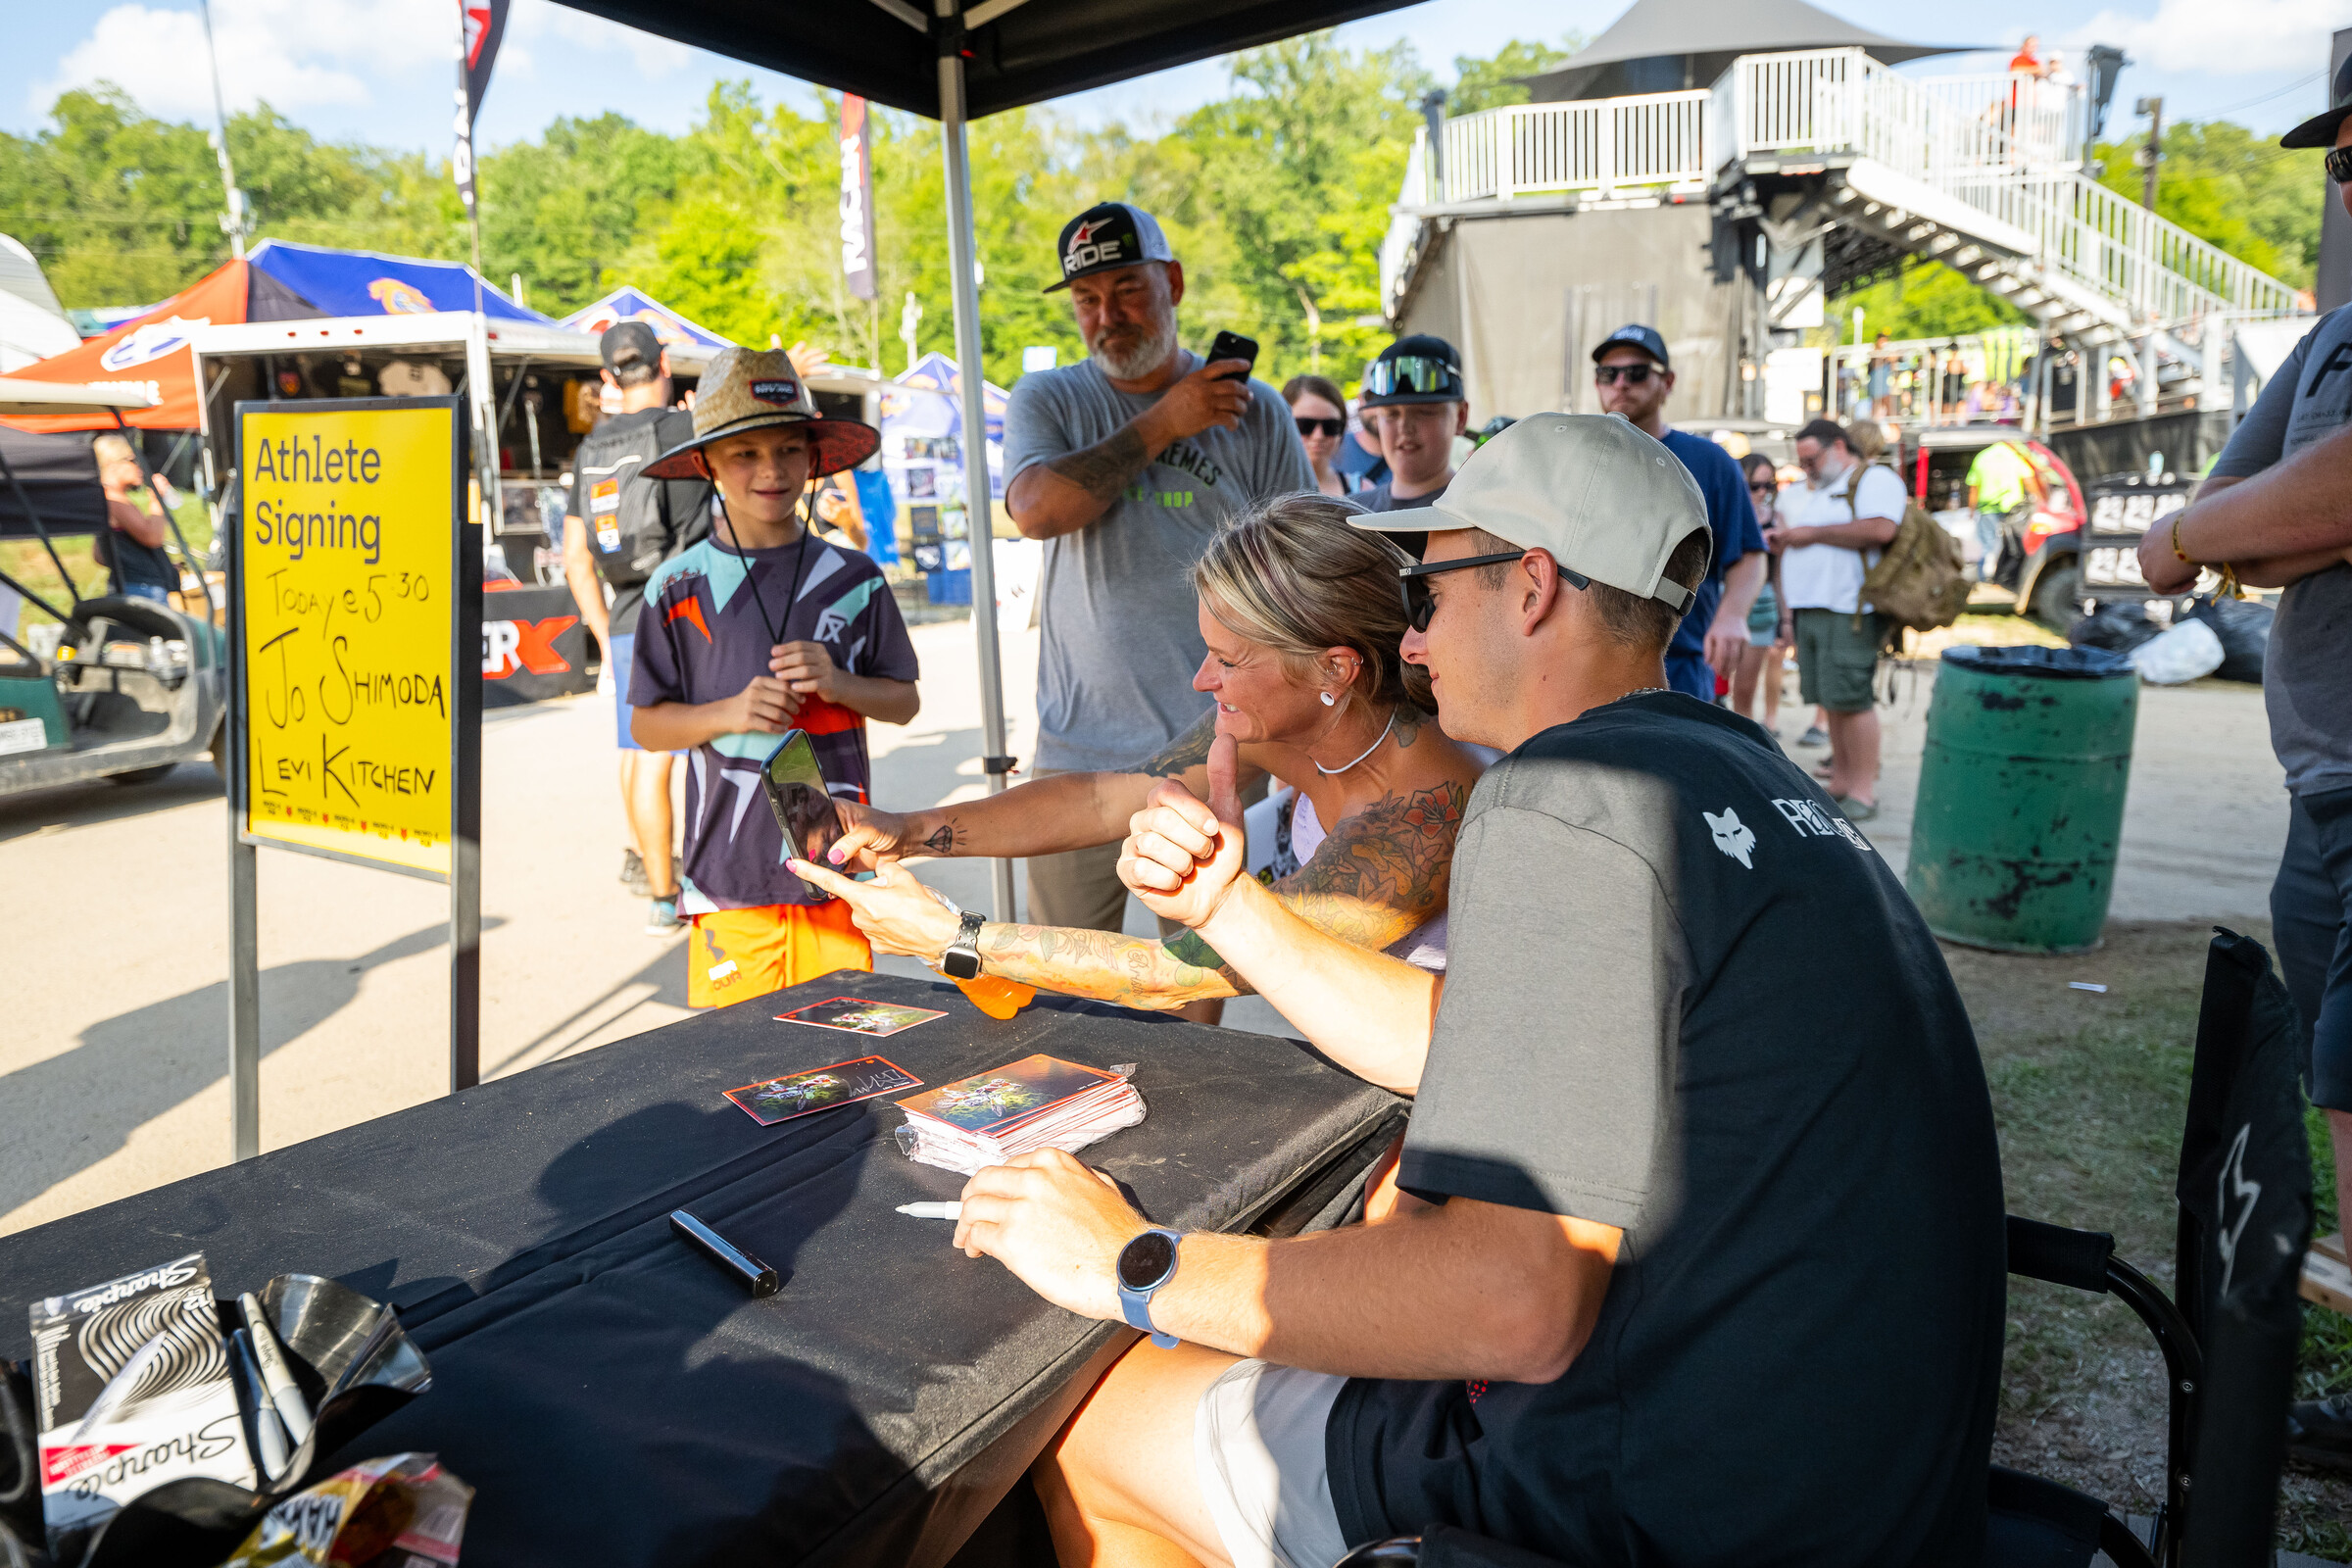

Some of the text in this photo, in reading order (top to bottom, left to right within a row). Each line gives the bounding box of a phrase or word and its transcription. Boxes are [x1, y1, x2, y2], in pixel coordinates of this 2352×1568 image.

[1063, 239, 1123, 276] RIDE
[255, 434, 381, 483] Athlete
[255, 500, 381, 564] Signing
[74, 1252, 203, 1313] Sharpie
[65, 1412, 240, 1502] Sharpie
